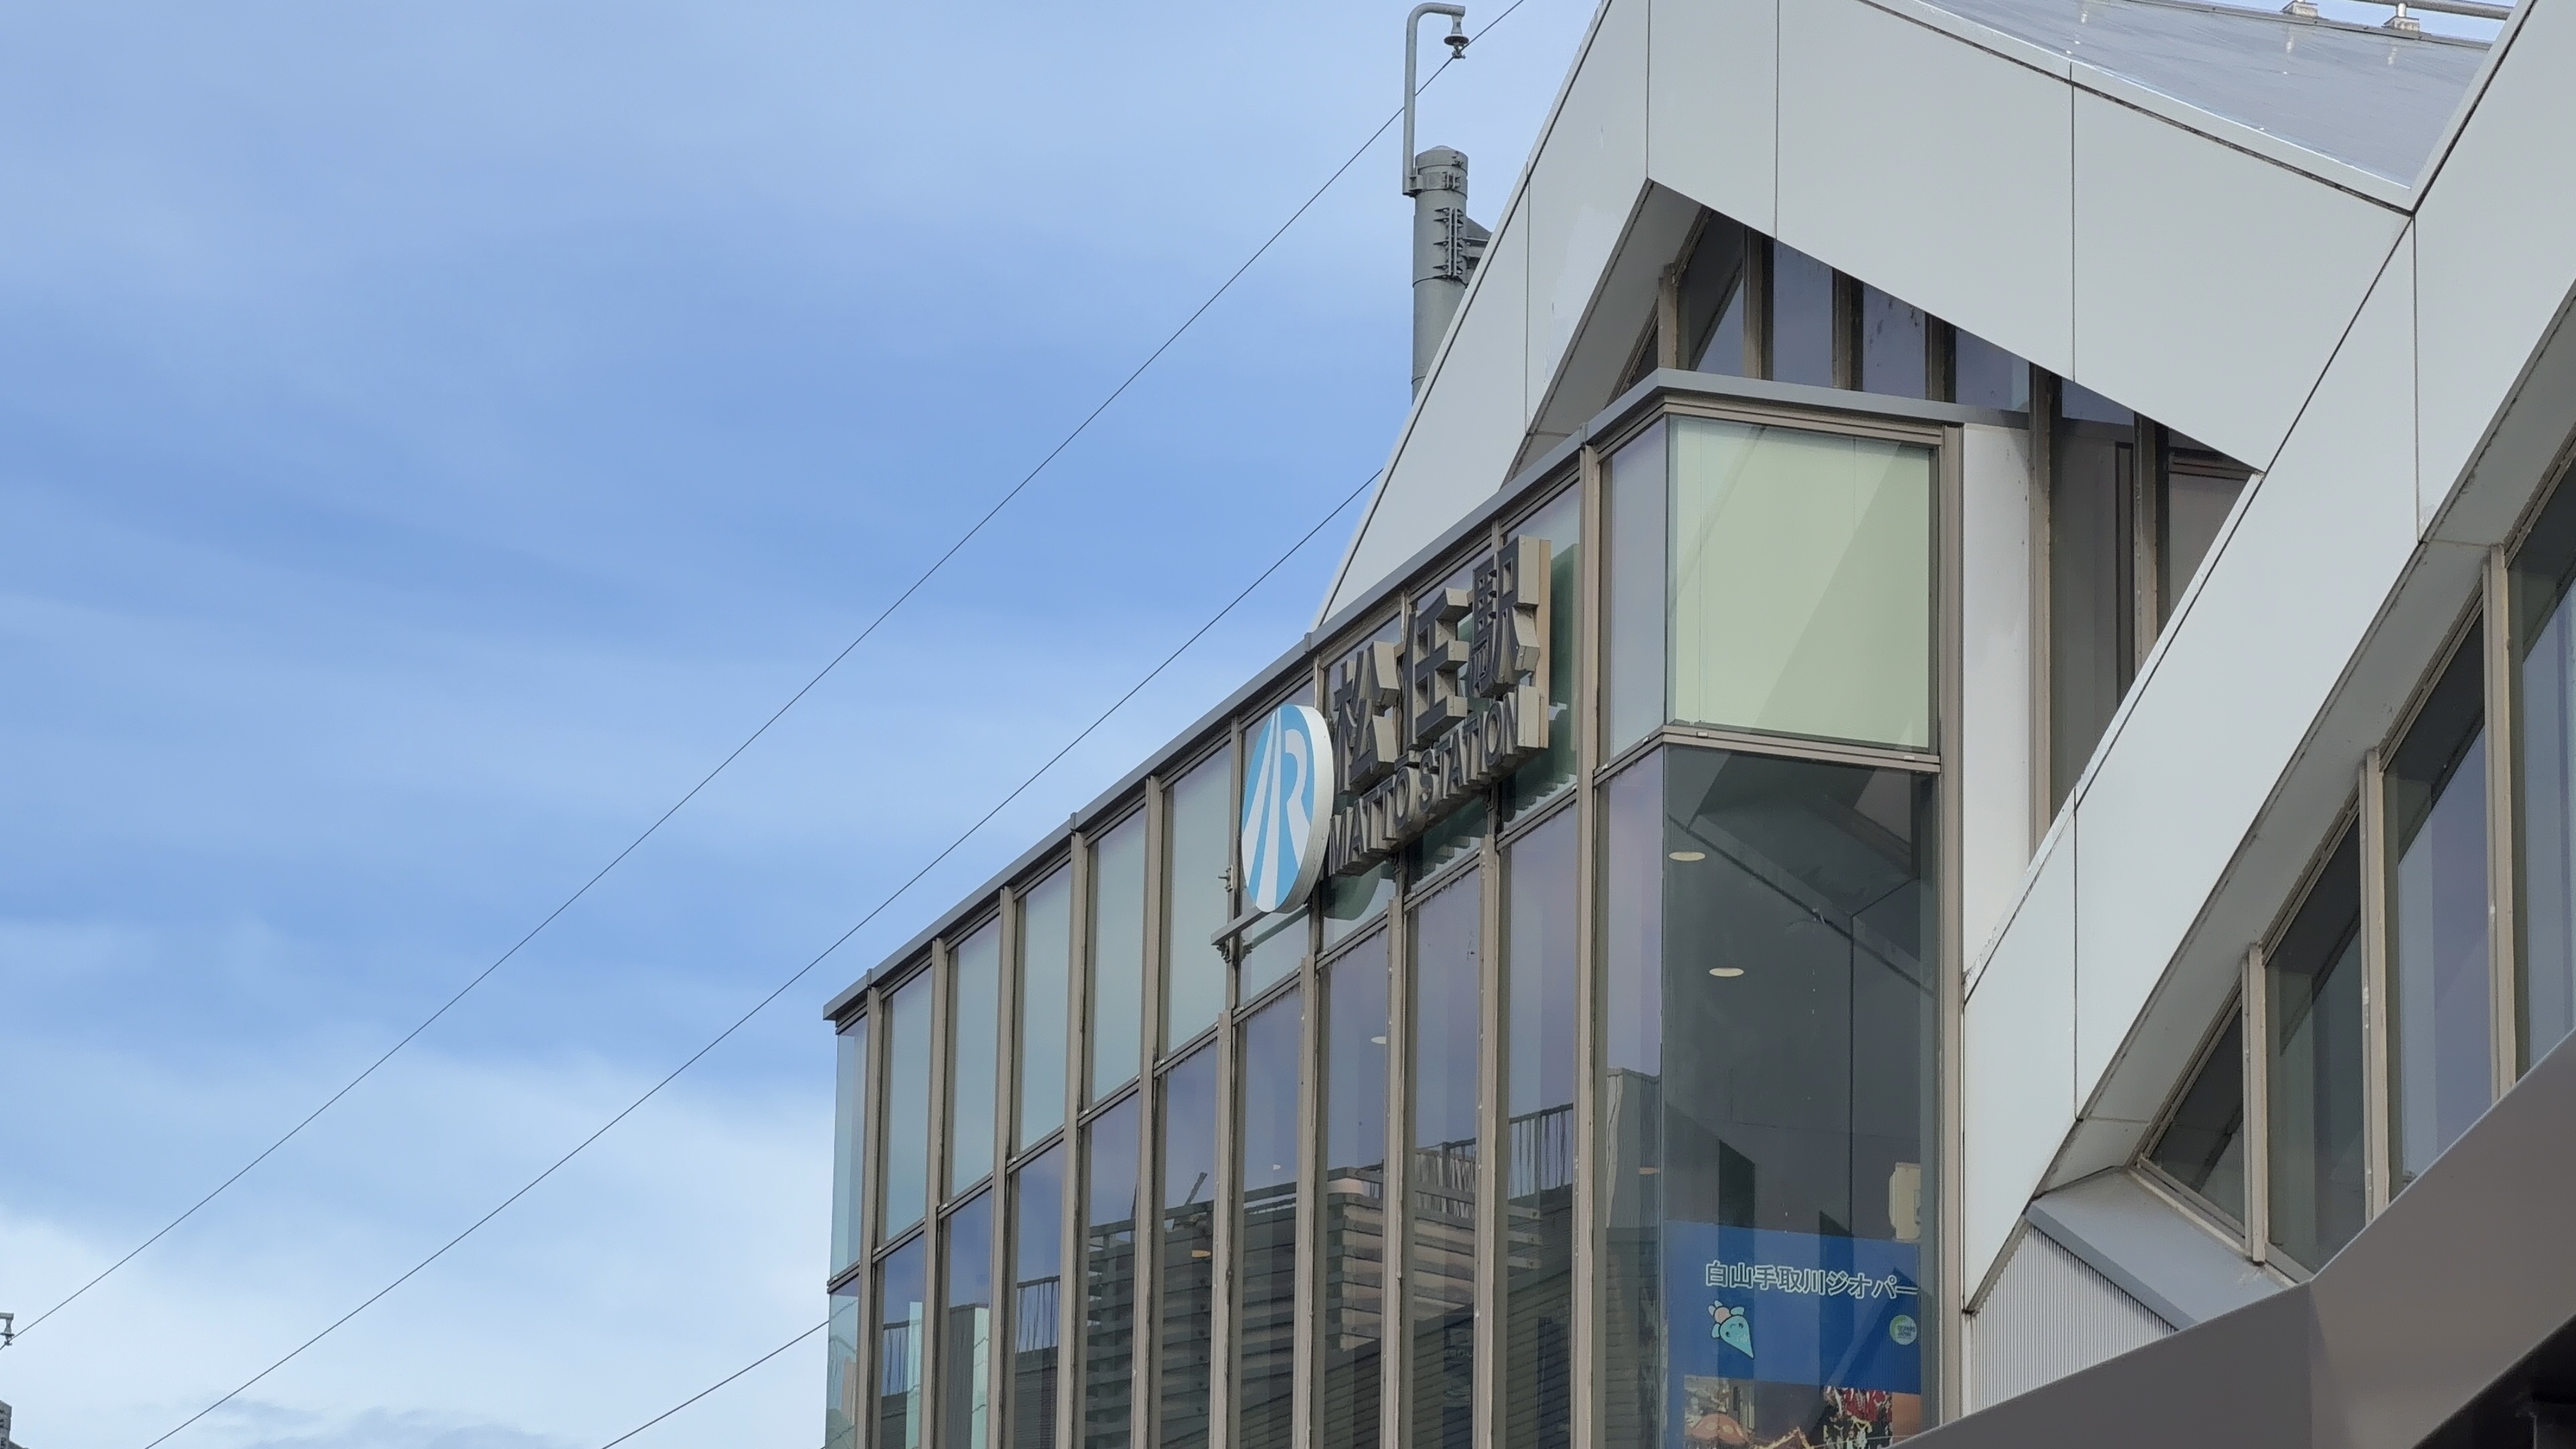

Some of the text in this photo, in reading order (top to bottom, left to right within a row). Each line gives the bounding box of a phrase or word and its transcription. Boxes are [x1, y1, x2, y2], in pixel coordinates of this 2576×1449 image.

[1332, 535, 1539, 794] 松任駅
[1328, 684, 1536, 875] MATTO STATION
[1705, 1260, 1919, 1299] 白山手取川ジオパー
